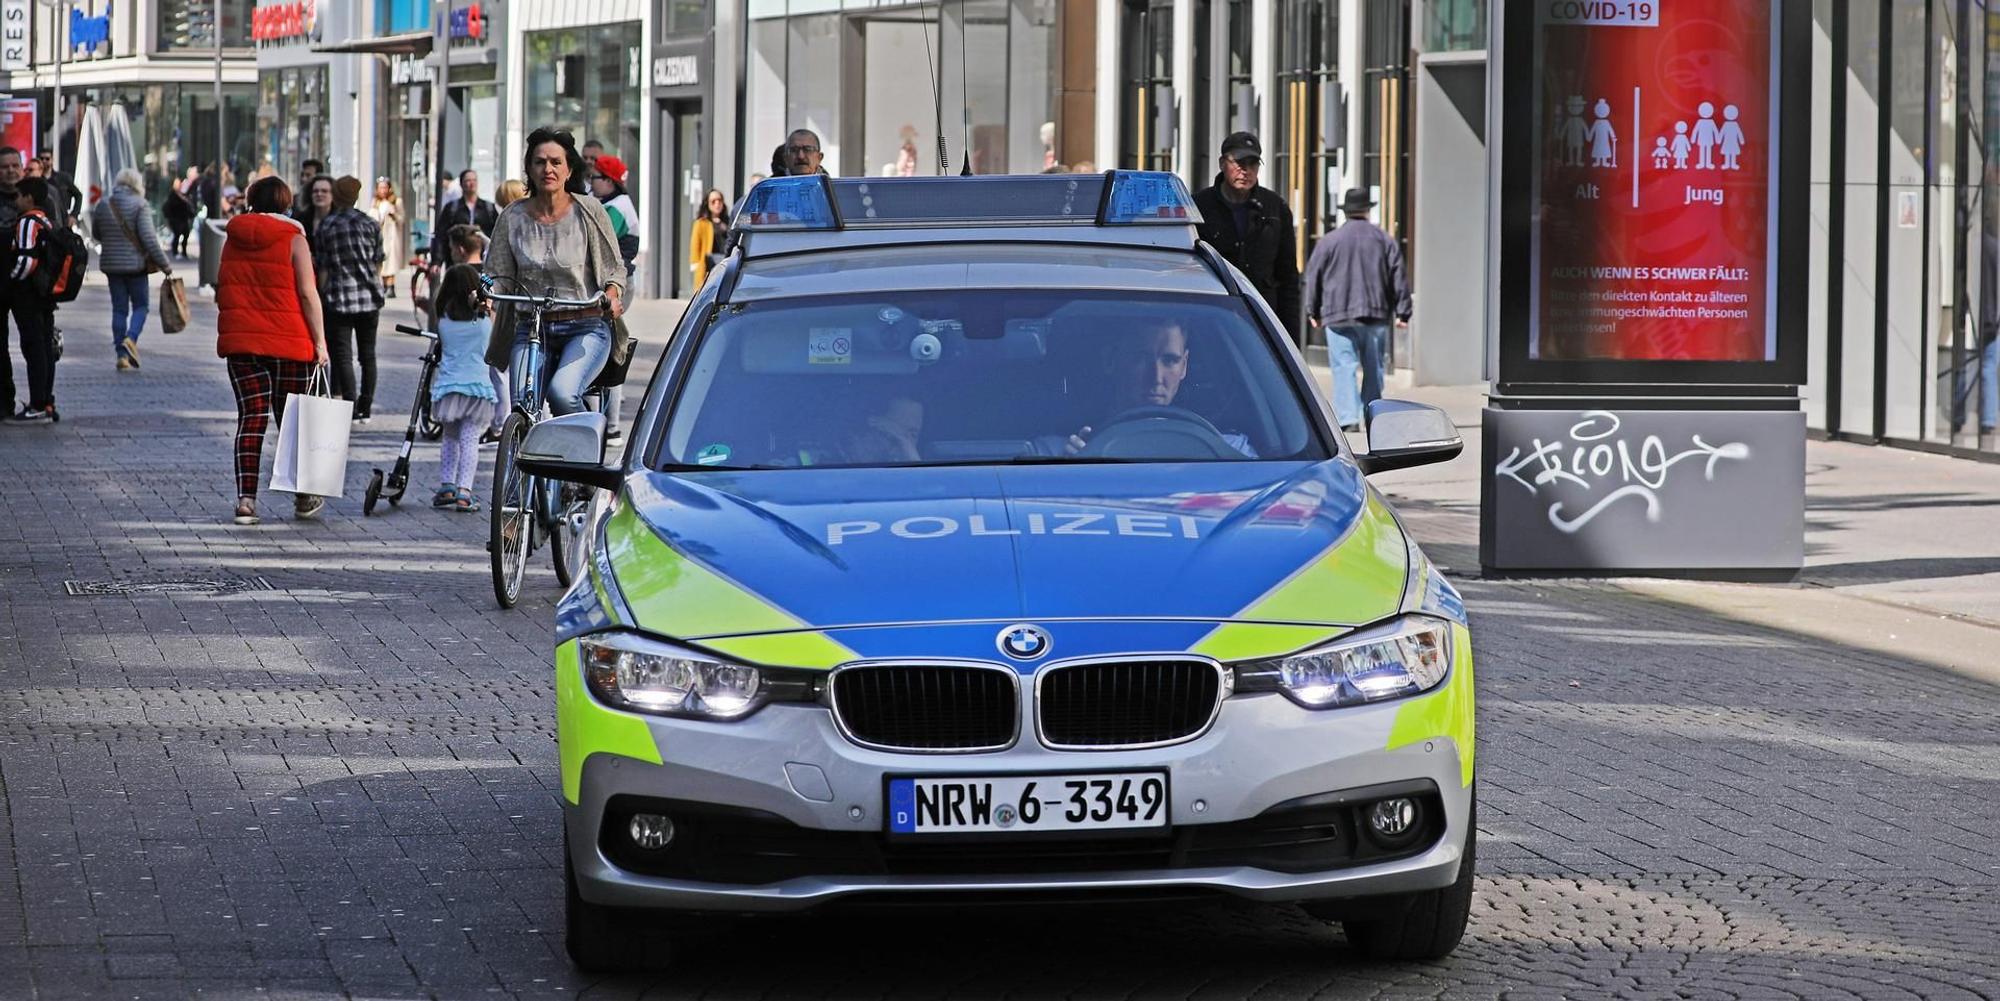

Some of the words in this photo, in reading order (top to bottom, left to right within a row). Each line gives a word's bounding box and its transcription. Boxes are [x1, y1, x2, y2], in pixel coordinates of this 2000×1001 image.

[1551, 2, 1652, 21] COVID-19
[6, 8, 24, 61] RES
[1575, 183, 1599, 199] Alt
[1684, 185, 1724, 205] Jung
[1589, 267, 1632, 279] WENN
[1634, 267, 1649, 280] ES
[1651, 268, 1707, 280] SCHWER
[1709, 265, 1749, 281] FÄLLT:
[1602, 290, 1648, 302] direkten
[1650, 291, 1693, 303] Kontakt
[1694, 294, 1709, 303] zu
[1710, 291, 1748, 303] älteren
[1698, 307, 1748, 319] Personen
[826, 512, 1200, 546] POLIZEI
[915, 782, 992, 827] NRW
[1018, 778, 1164, 825] 6-3349
[897, 812, 908, 824] D
